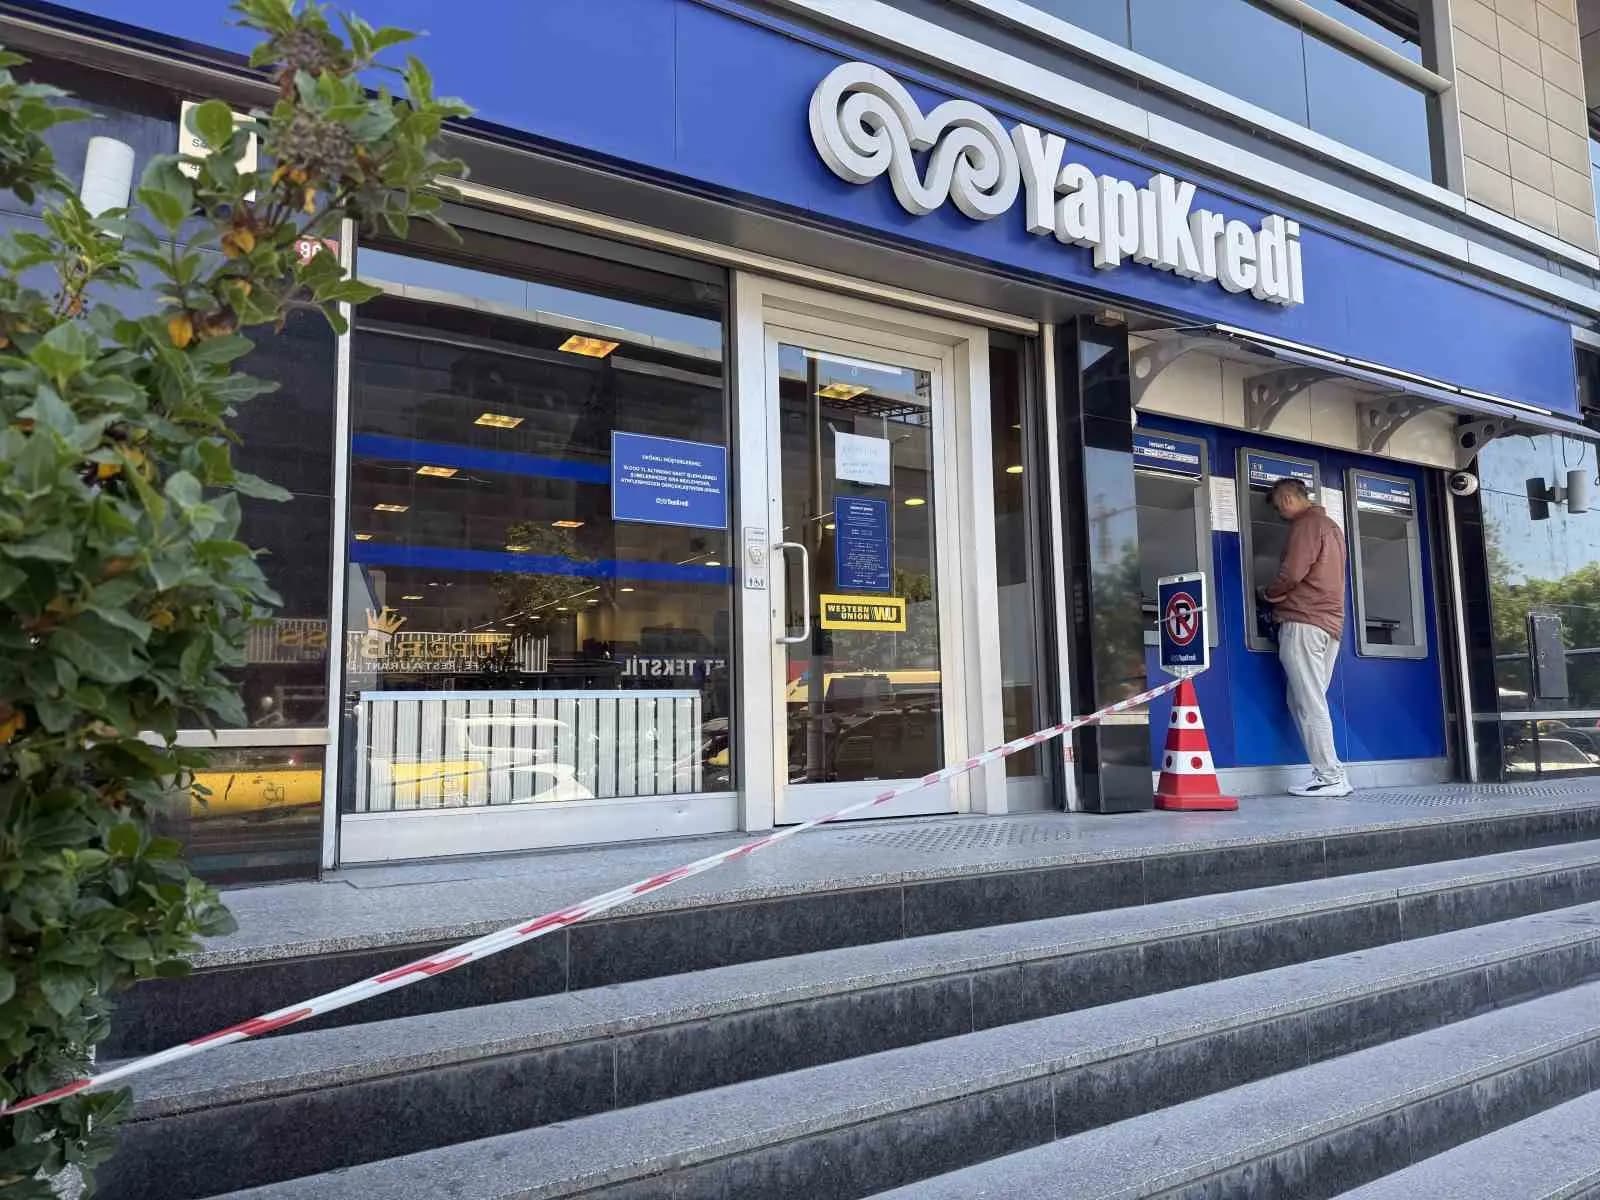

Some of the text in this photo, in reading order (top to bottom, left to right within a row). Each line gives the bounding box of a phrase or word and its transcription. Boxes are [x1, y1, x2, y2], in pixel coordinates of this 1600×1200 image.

[1011, 123, 1304, 305] YapıKredi
[827, 605, 869, 613] WESTERN
[841, 612, 870, 620] UNION
